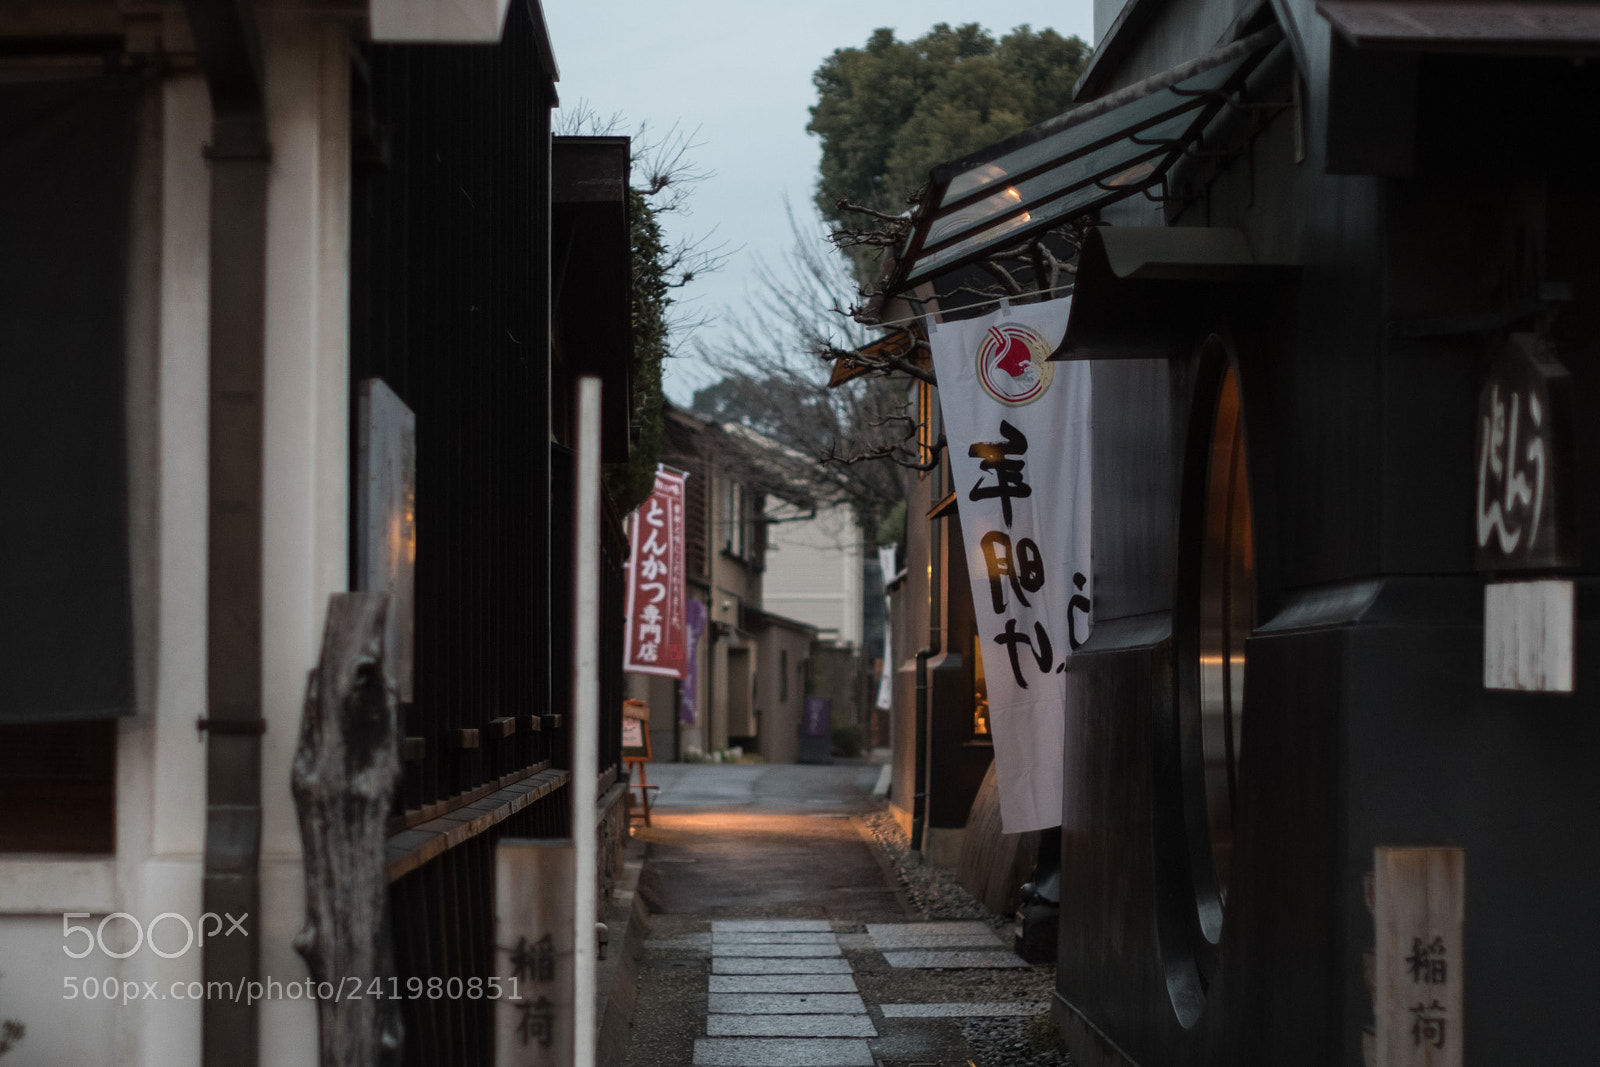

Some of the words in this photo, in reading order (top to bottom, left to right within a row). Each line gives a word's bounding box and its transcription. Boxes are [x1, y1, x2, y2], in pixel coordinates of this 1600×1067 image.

[637, 498, 667, 662] とんかつ専門店
[510, 932, 556, 1047] 稲荷
[1405, 936, 1448, 1050] 稲荷
